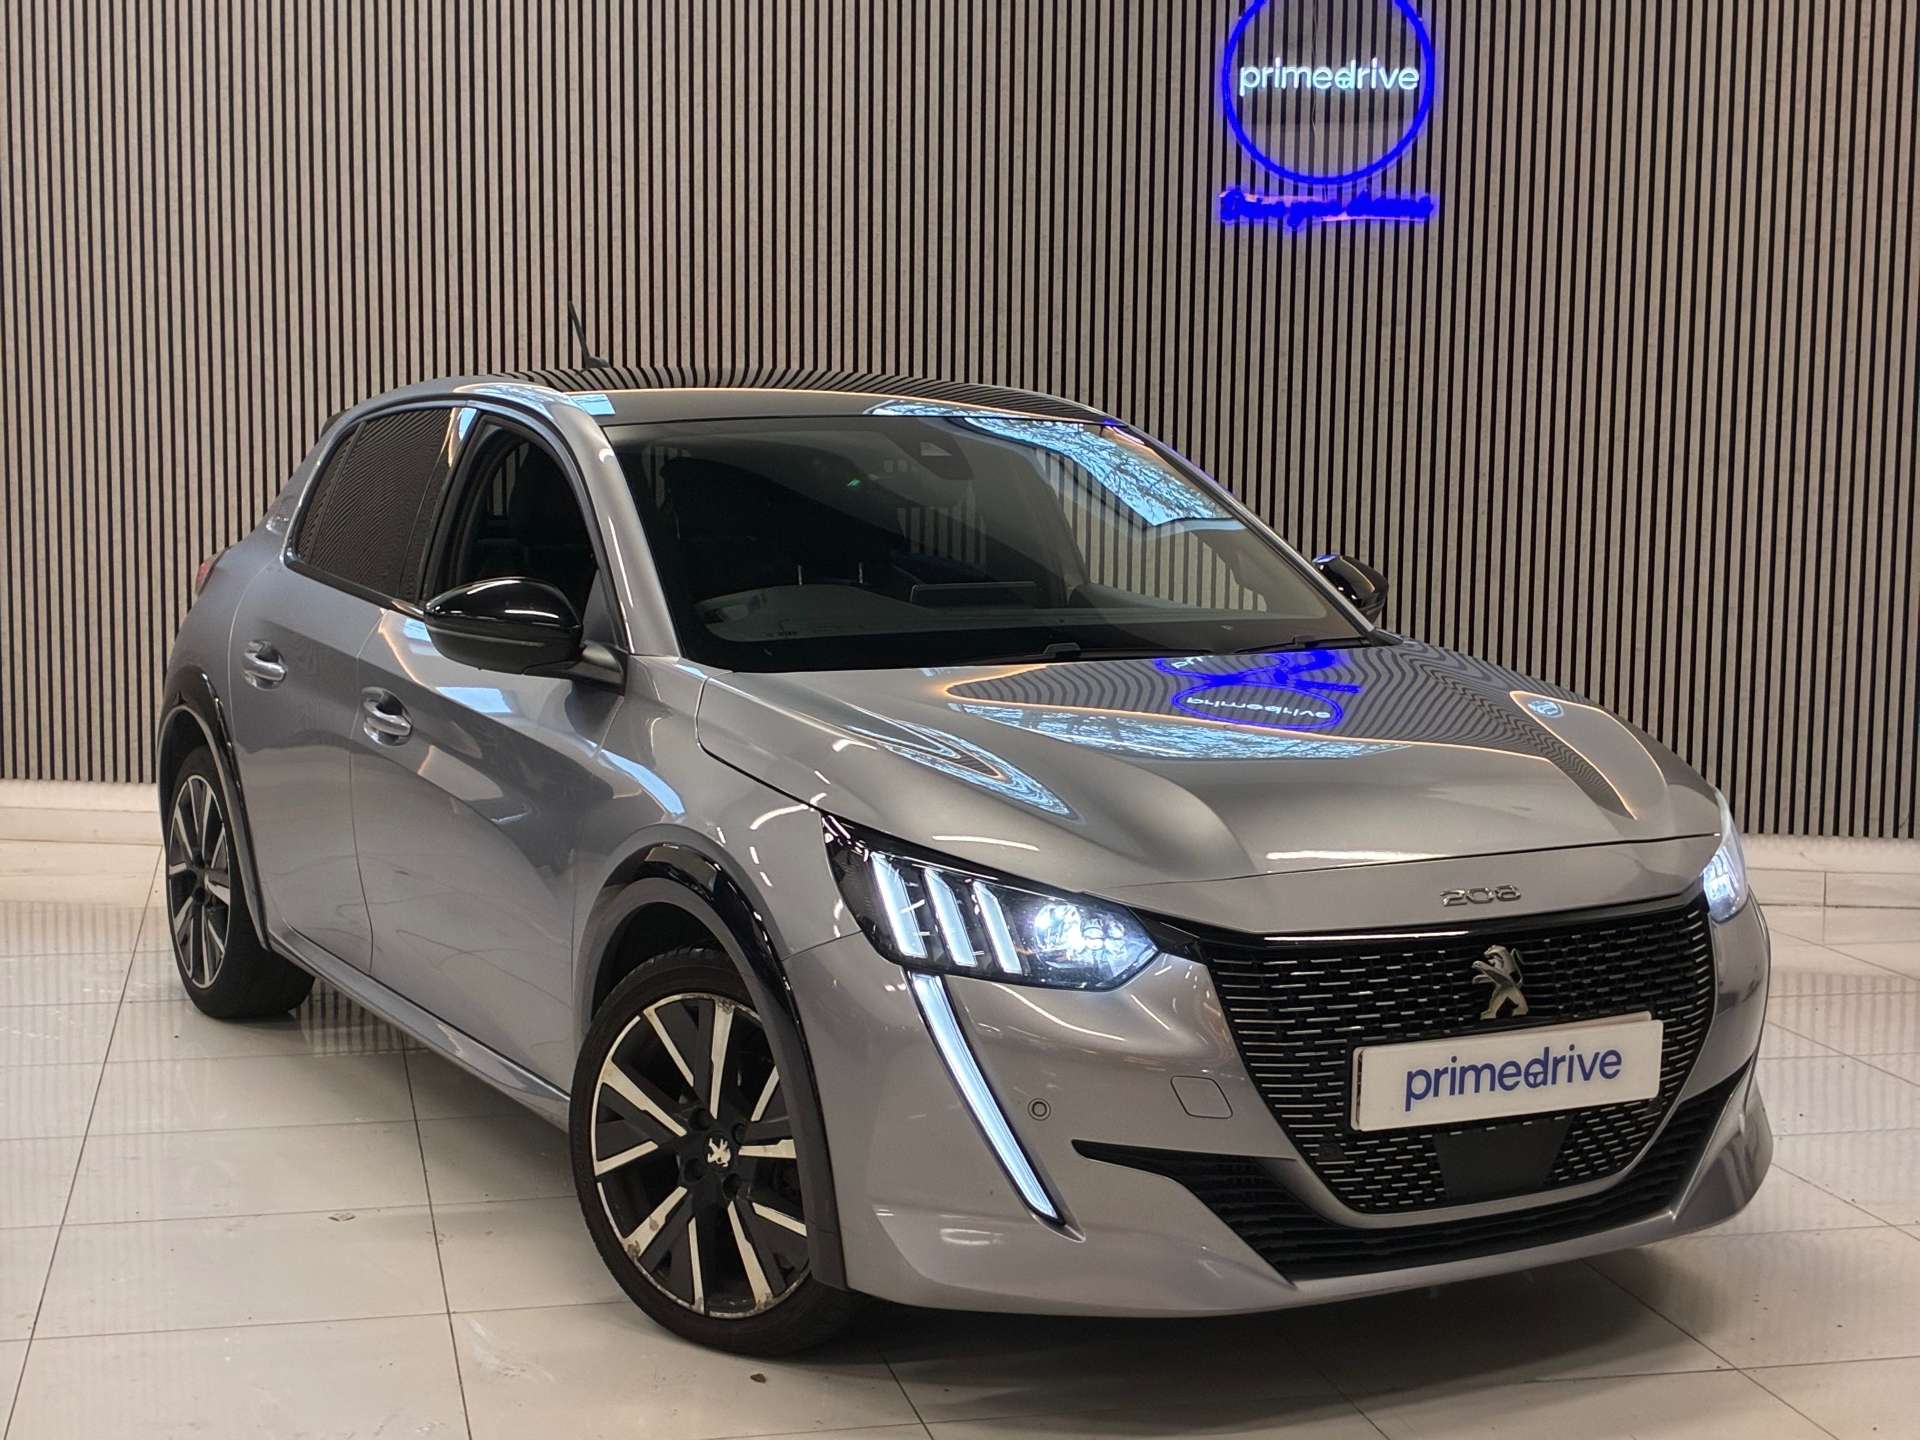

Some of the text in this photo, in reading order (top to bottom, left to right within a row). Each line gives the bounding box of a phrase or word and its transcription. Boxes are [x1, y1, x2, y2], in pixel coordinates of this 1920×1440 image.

[1239, 56, 1420, 97] primedrive
[1440, 884, 1522, 907] 208
[1404, 1043, 1623, 1112] primedrive
